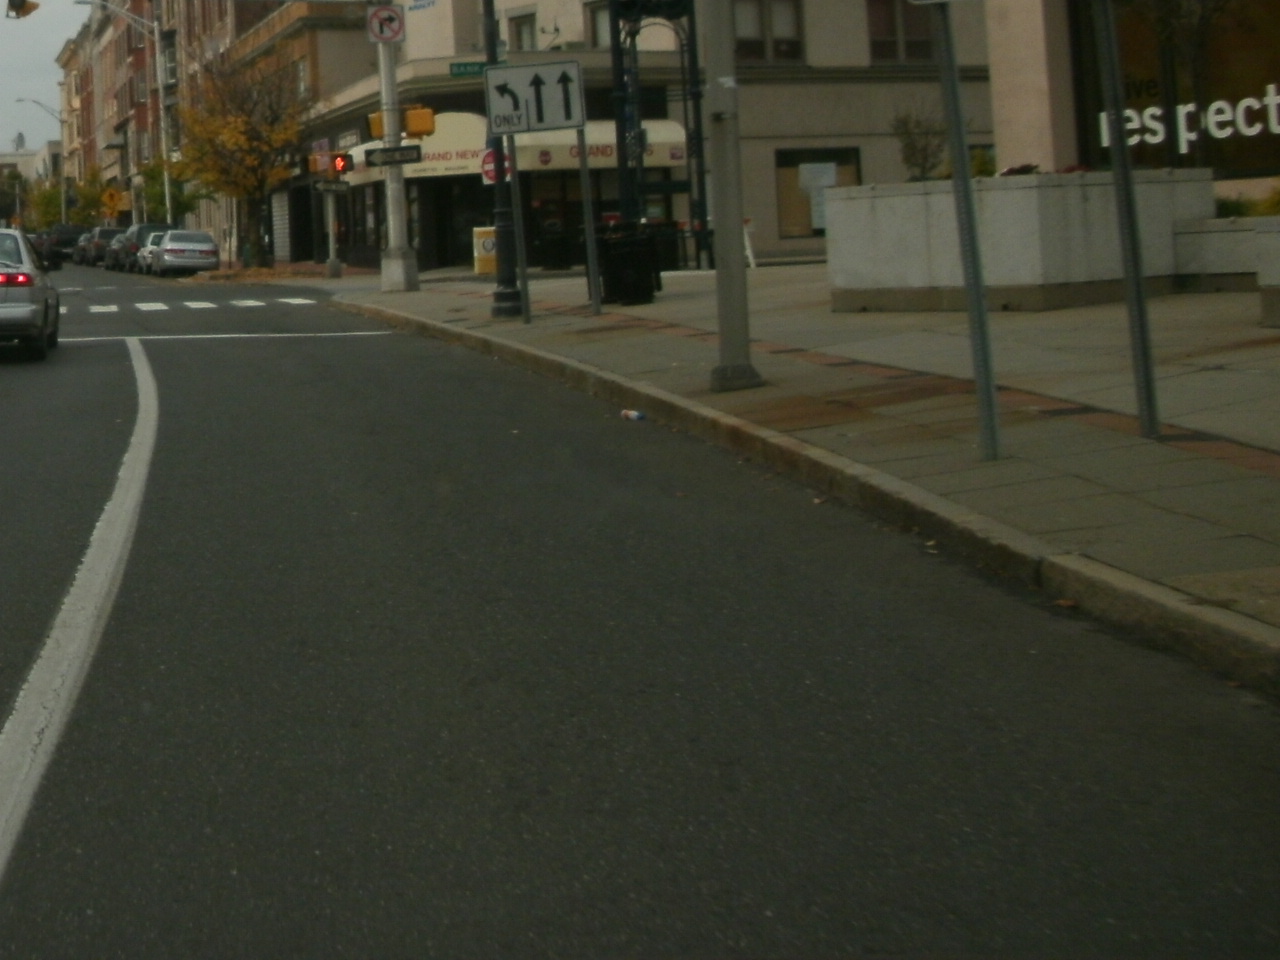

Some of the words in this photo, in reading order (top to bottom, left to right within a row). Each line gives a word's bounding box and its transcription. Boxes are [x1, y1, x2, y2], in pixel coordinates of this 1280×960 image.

[494, 113, 523, 128] ONLY
[422, 151, 453, 162] RAND
[569, 144, 614, 158] GAND
